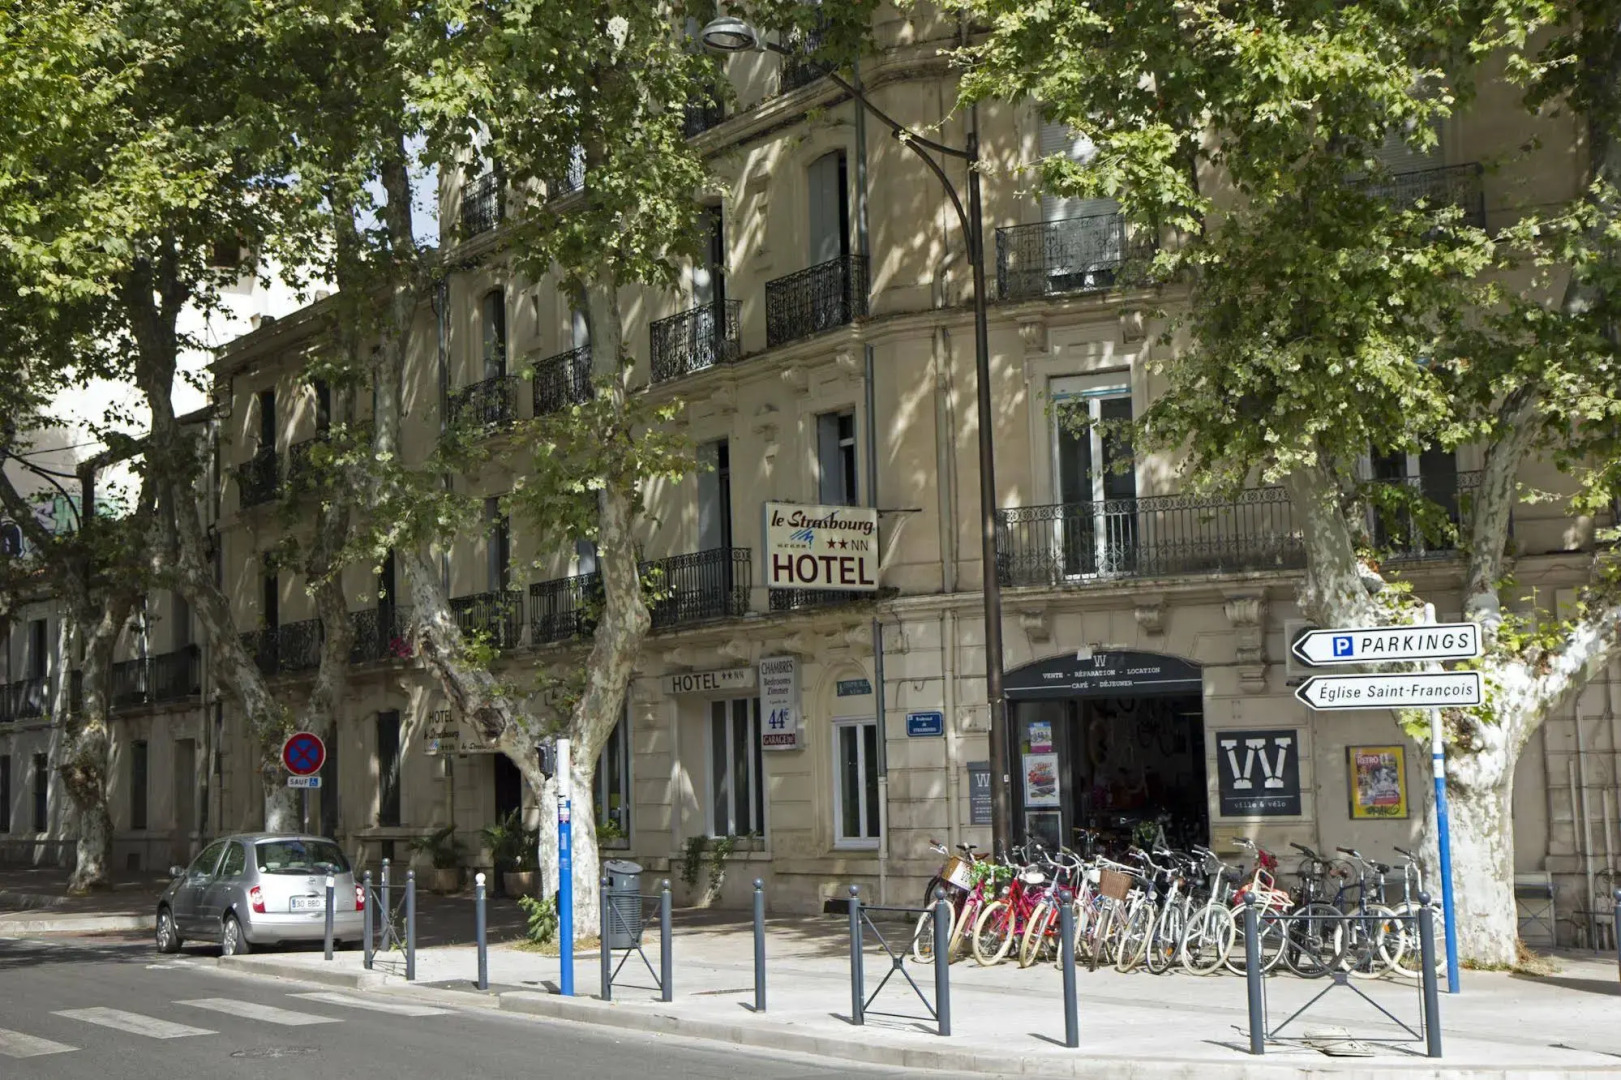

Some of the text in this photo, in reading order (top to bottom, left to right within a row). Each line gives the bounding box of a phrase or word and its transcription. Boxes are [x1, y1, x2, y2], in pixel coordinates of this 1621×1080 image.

[772, 510, 874, 536] le Strasbourg
[773, 554, 874, 585] HOTEL
[1335, 633, 1469, 655] P PARKINGS
[761, 660, 794, 675] CHAMBRES
[1074, 669, 1116, 678] RÉPARATION
[1127, 667, 1160, 675] LOCATION
[672, 673, 720, 692] HOTEL
[764, 678, 792, 686] Bedrooms
[1099, 680, 1134, 688] DÉJEUNER
[768, 687, 789, 696] Zimmer
[1320, 682, 1473, 702] Église Saint-François
[428, 710, 454, 724] HOTEL
[1234, 801, 1257, 809] ville
